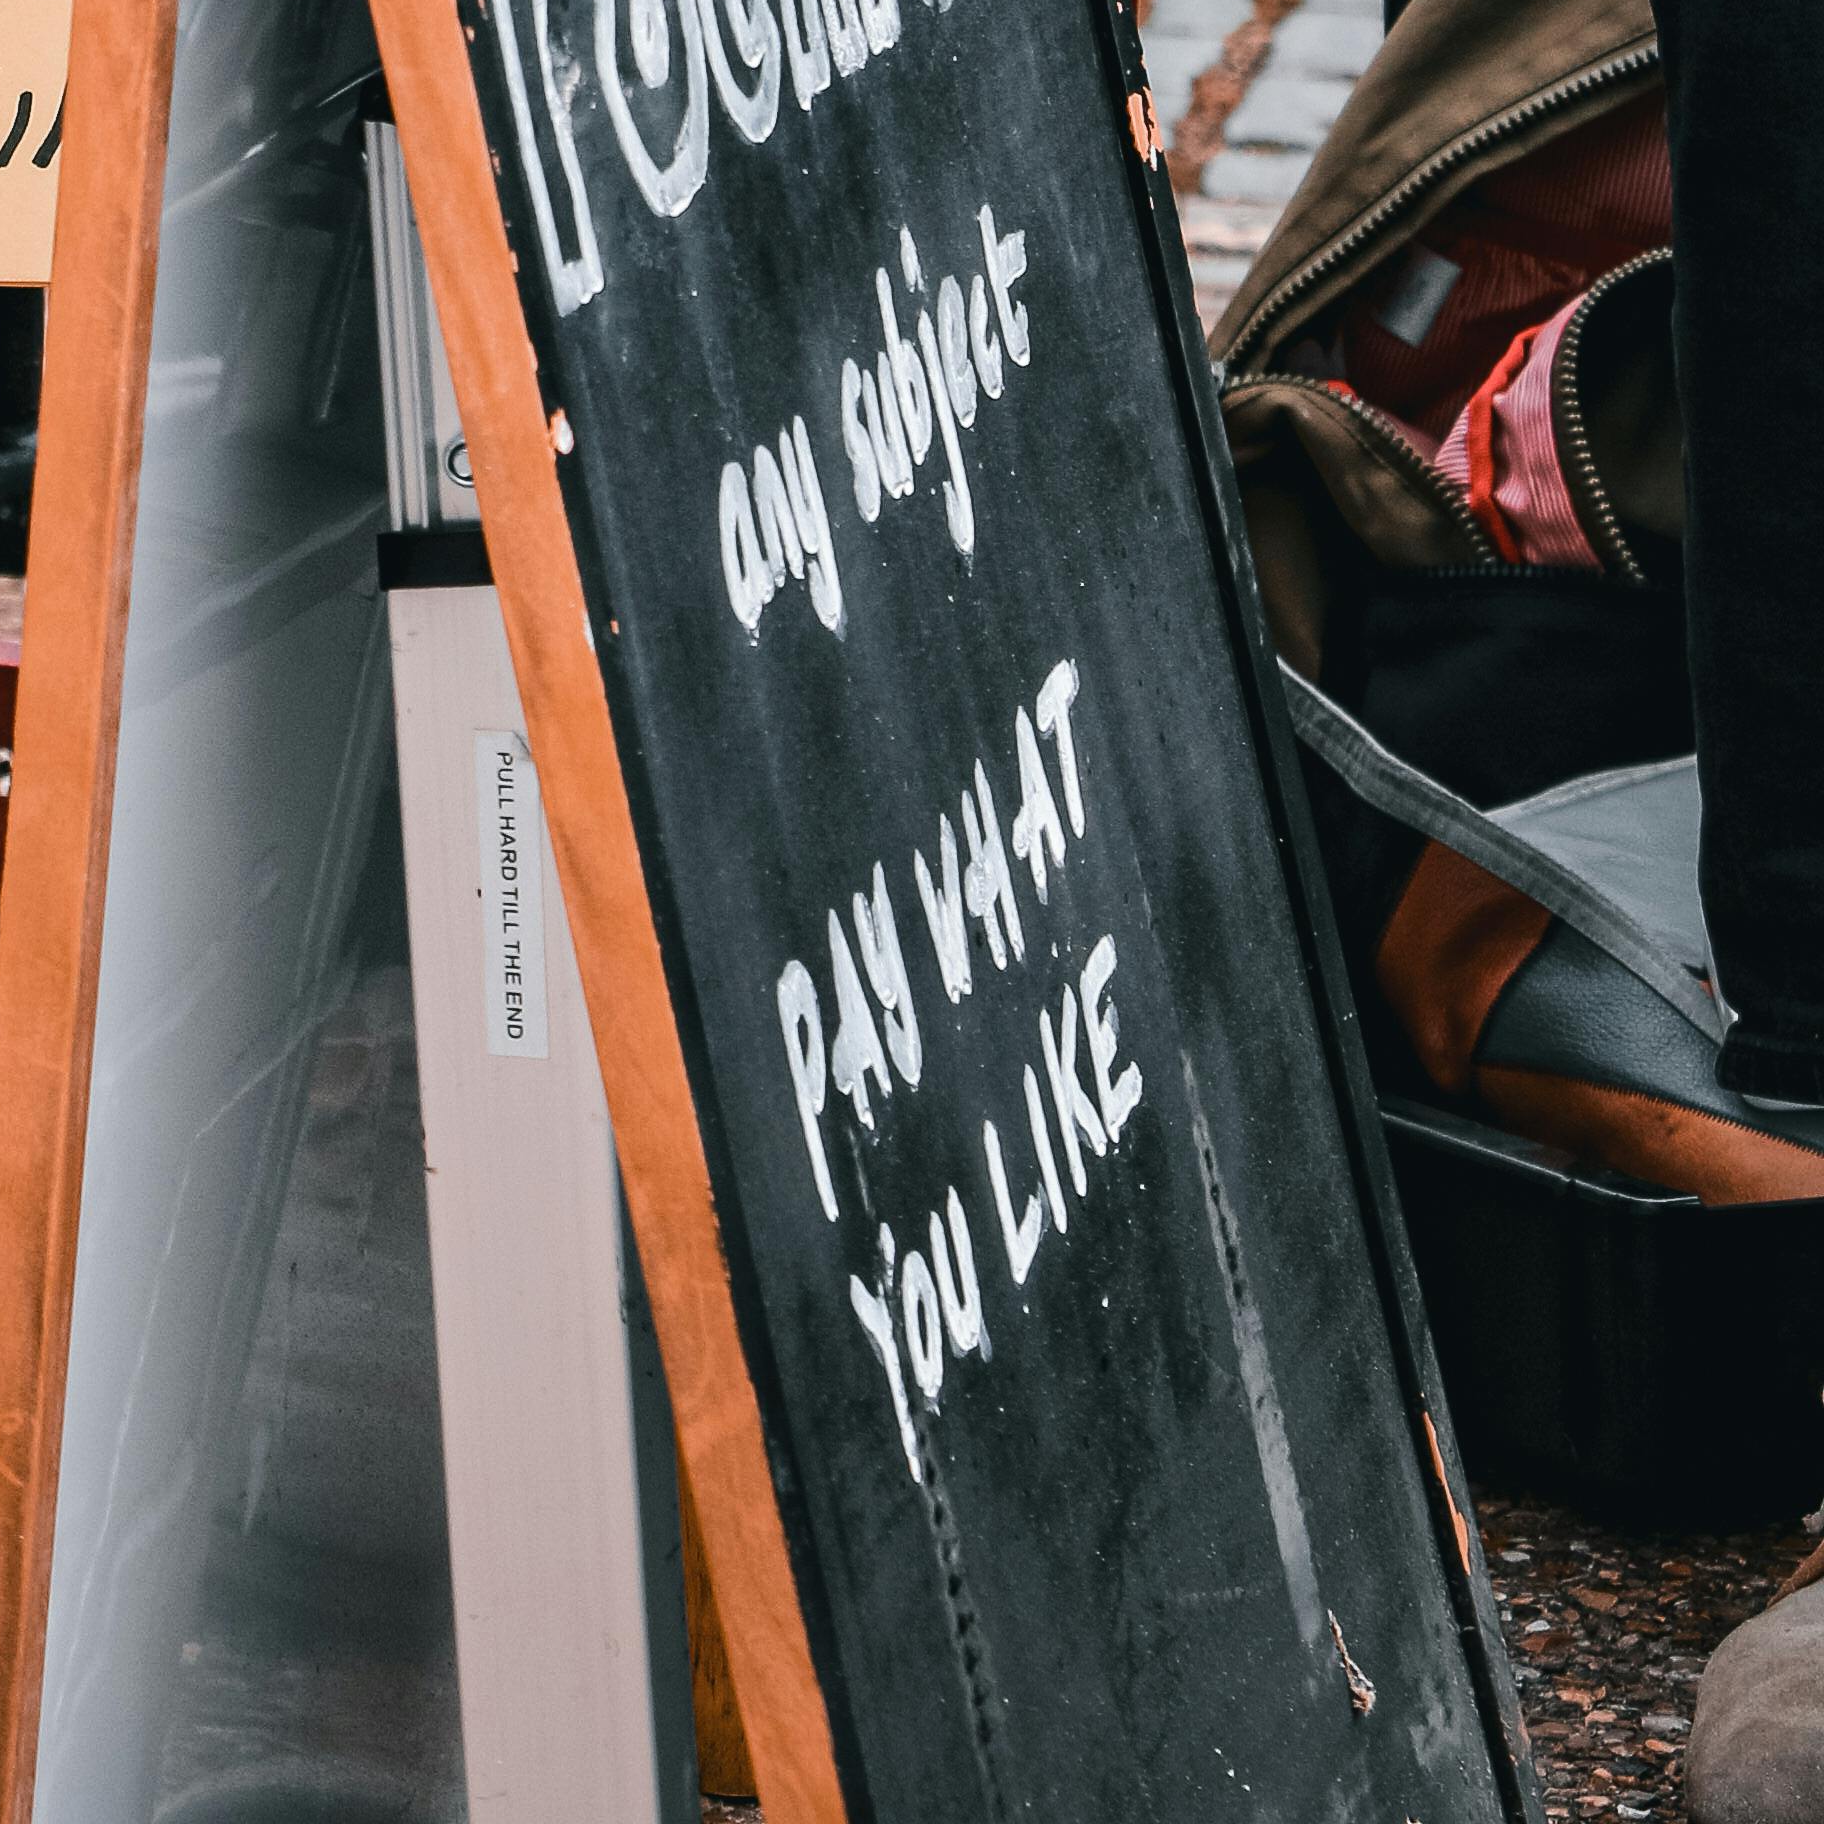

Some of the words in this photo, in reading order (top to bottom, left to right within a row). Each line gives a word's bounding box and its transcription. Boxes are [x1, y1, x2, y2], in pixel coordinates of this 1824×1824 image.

[718, 414, 846, 642] any
[841, 202, 1029, 559] subject
[496, 751, 514, 810] PULL
[499, 815, 518, 882] HARD
[501, 887, 520, 935] TILL
[777, 860, 923, 1220] PAY
[914, 658, 1088, 1004] WHAT
[503, 939, 522, 986] THE
[505, 991, 524, 1040] END
[984, 934, 1143, 1287] LIKE
